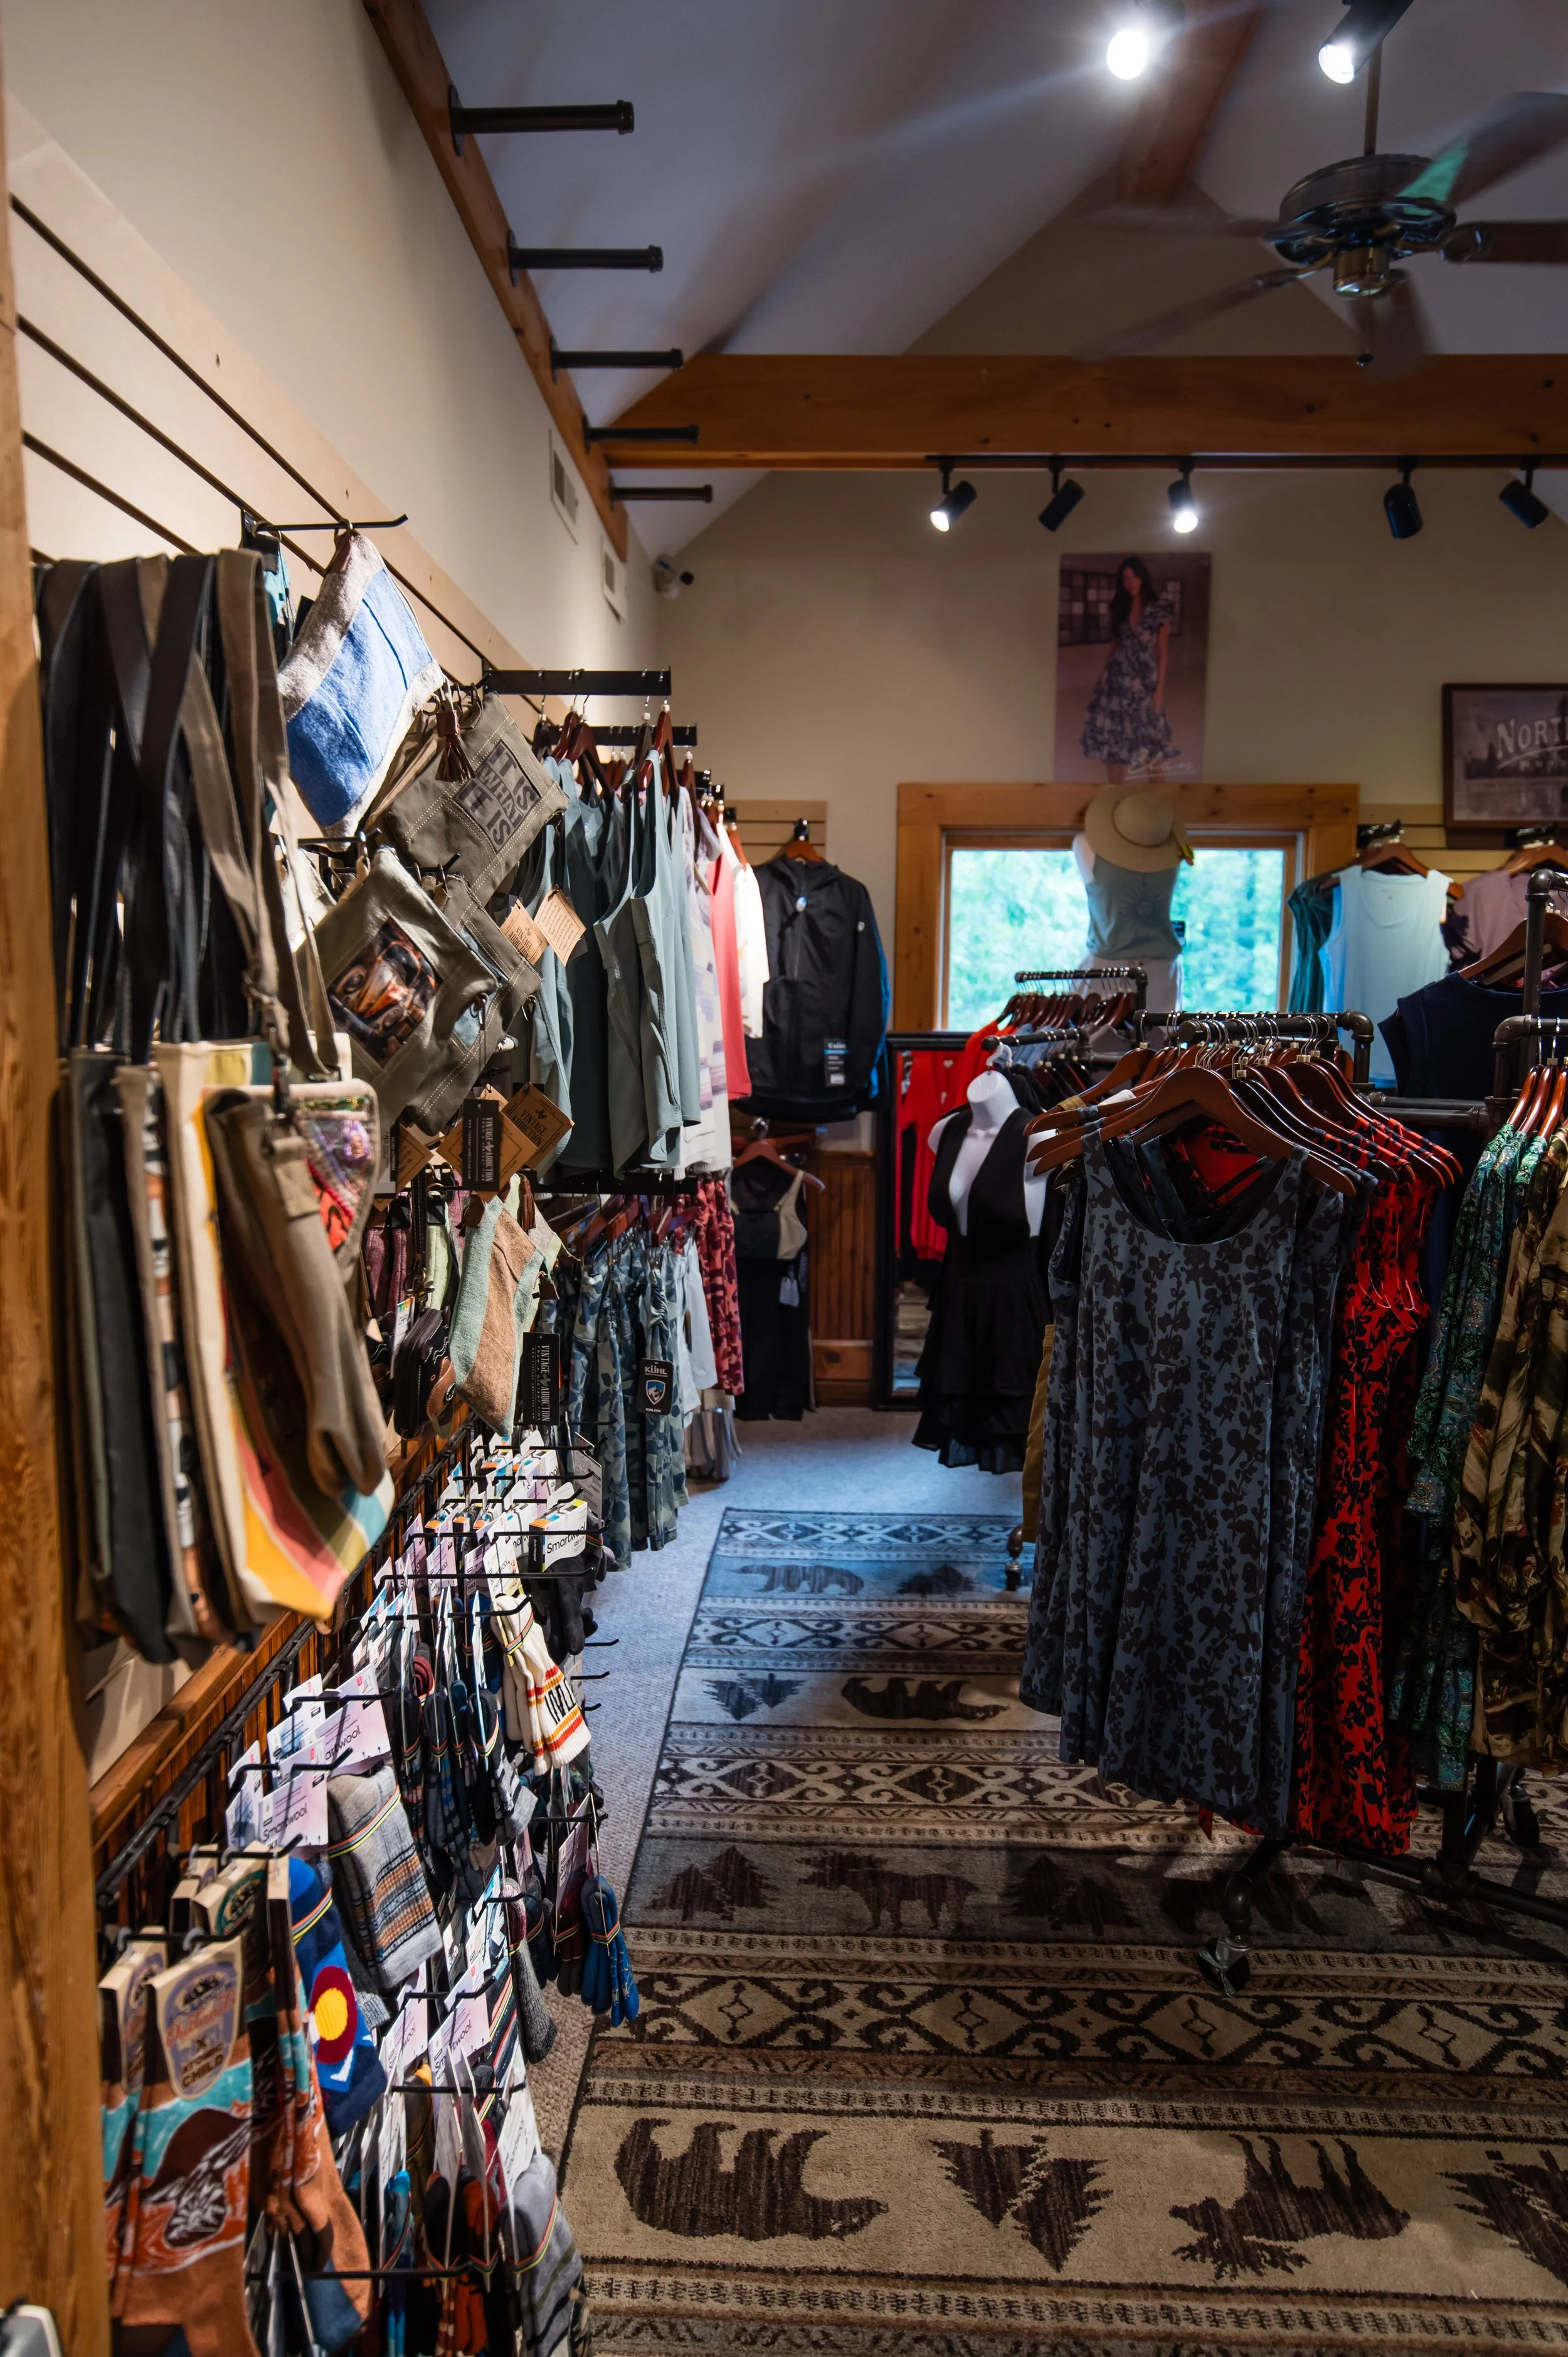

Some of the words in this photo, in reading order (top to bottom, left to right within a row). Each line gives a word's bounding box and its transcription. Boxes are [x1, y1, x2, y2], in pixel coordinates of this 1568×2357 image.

[1497, 716, 1568, 759] NORT
[489, 743, 517, 777] IT
[513, 776, 534, 811] IS
[458, 780, 493, 813] IT
[486, 809, 511, 846] IS
[477, 766, 521, 828] WHAT
[516, 926, 533, 950] VINTAGE
[485, 1117, 494, 1141] VINTAGE
[512, 1115, 543, 1147] ADDICTION
[521, 1109, 548, 1136] VINTAGE
[485, 1152, 494, 1181] ADDICTION
[541, 1345, 550, 1374] VINTAGE
[644, 1365, 668, 1375] KÜHL
[541, 1386, 551, 1422] ADDICTION
[326, 1725, 362, 1760] artwool
[435, 2019, 472, 2073] Smrtwool
[183, 2054, 223, 2088] CHILD
